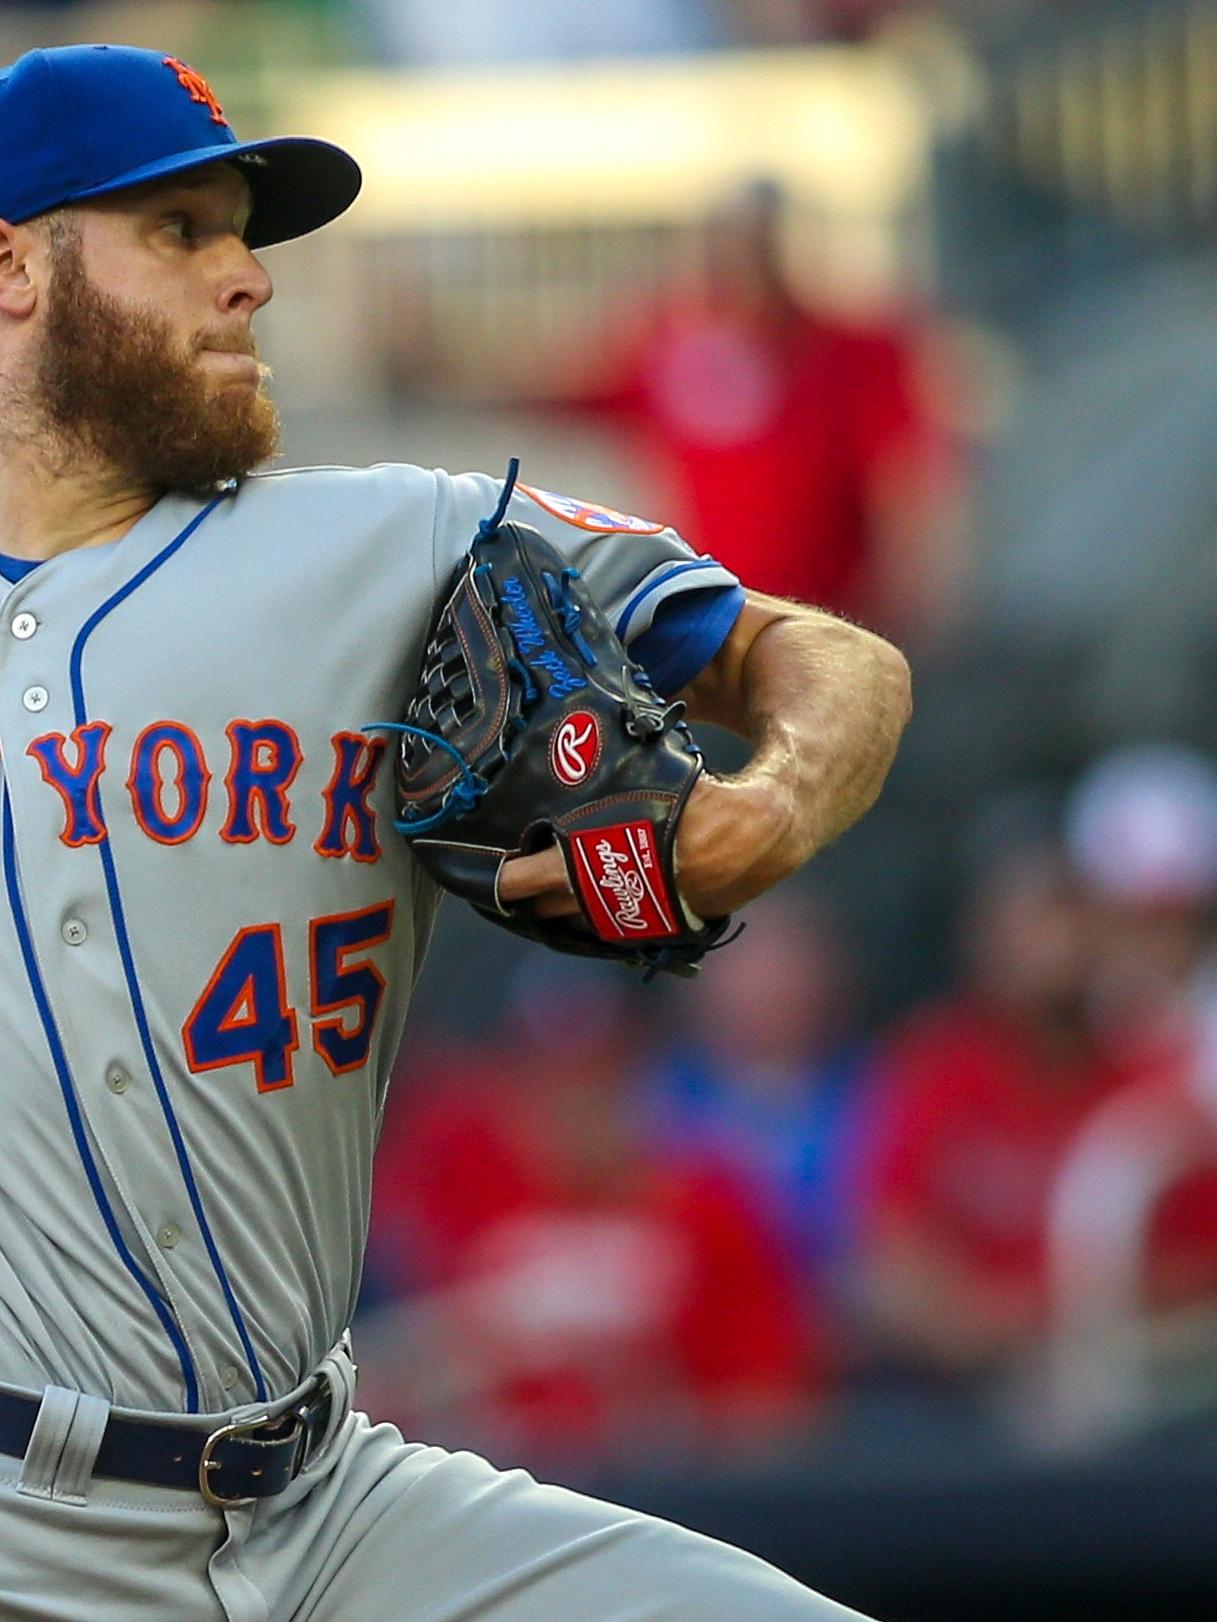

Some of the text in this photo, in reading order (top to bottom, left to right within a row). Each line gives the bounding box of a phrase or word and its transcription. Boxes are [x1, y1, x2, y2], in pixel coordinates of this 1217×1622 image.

[25, 718, 387, 863] YORK
[556, 722, 593, 780] R
[596, 839, 648, 930] Rawlings
[181, 900, 396, 1095] 45
